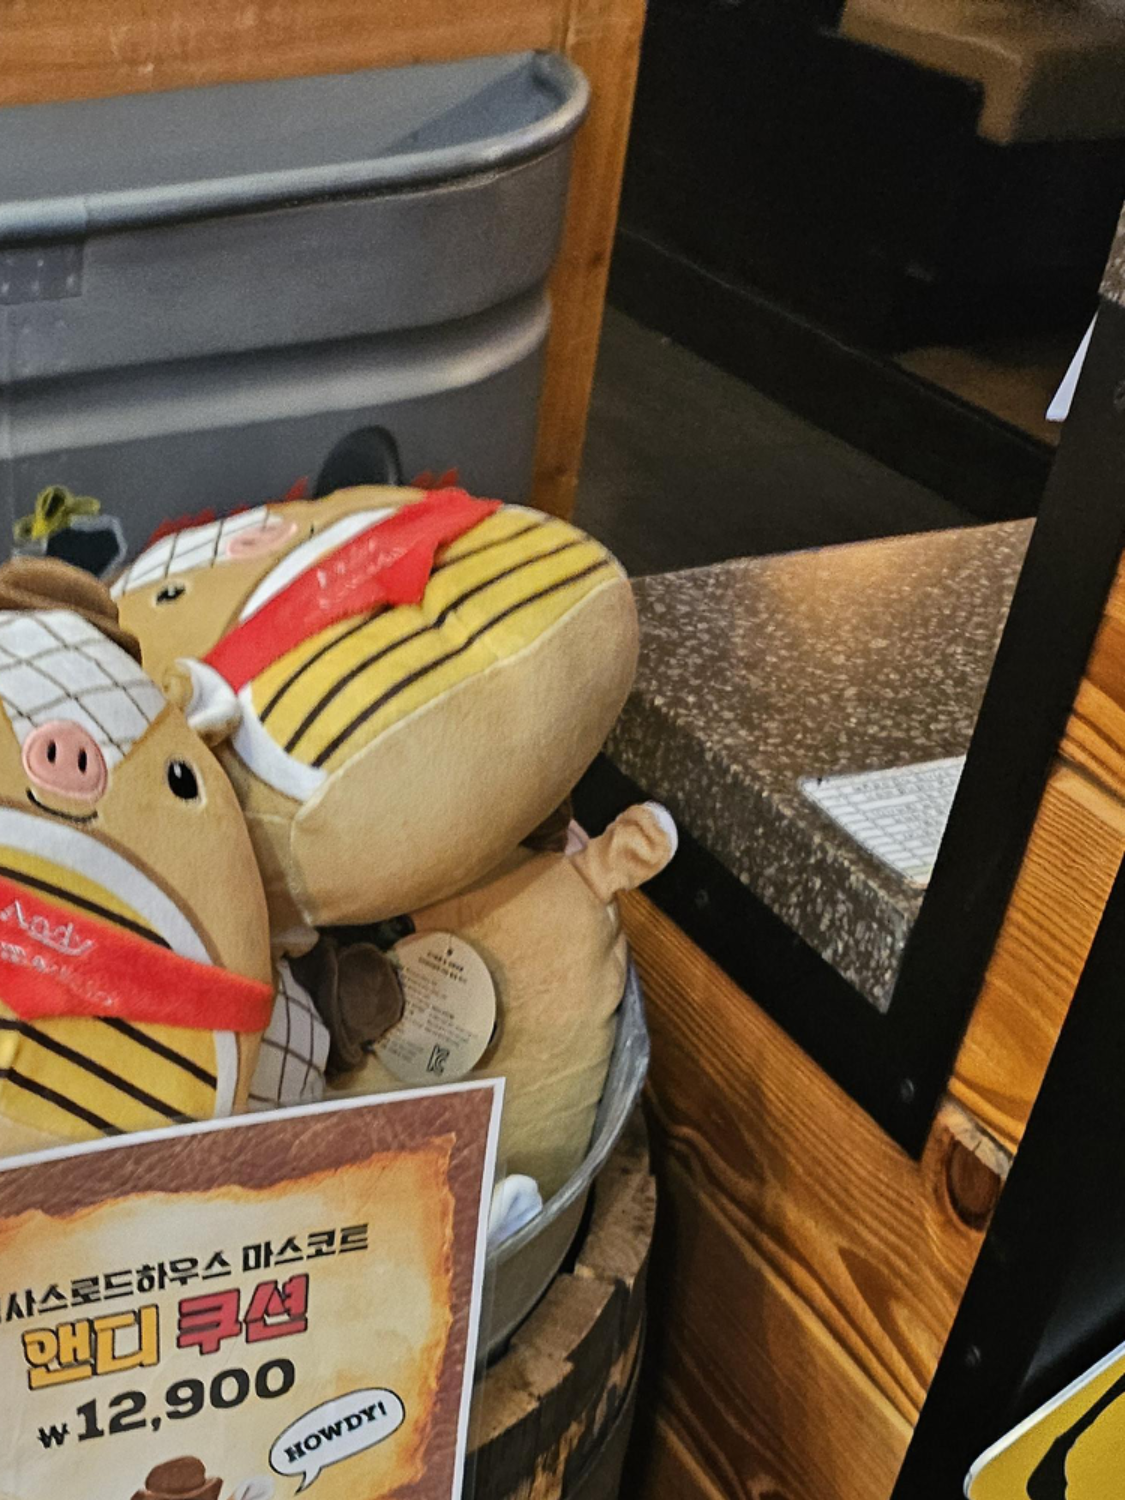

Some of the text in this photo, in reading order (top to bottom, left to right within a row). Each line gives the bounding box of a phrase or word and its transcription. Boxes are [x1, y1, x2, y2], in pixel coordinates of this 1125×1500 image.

[241, 1223, 370, 1273] 마스코트
[22, 1272, 310, 1391] 앤디 쿠션
[283, 1400, 388, 1464] HOWDY!
